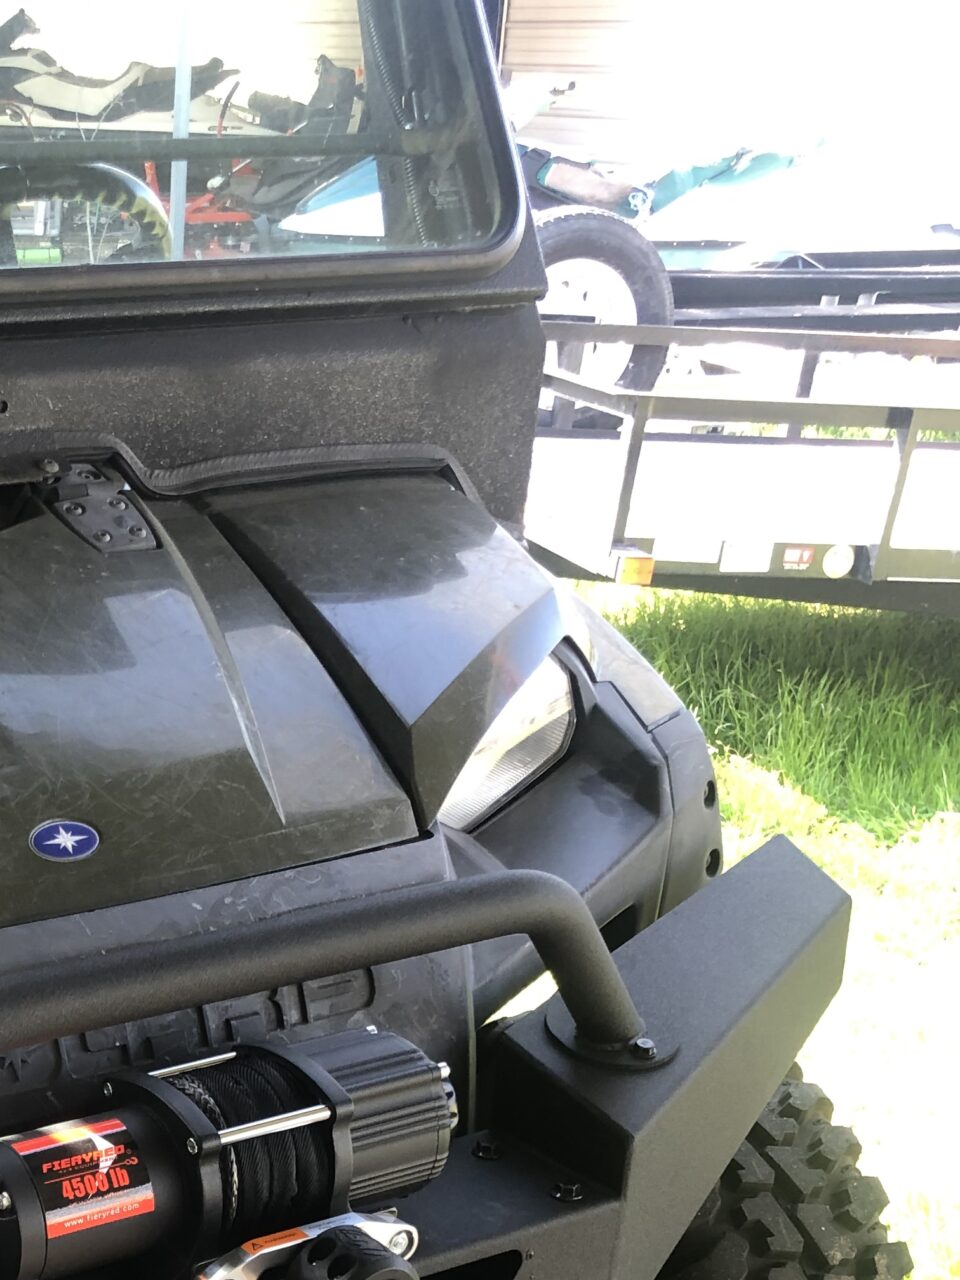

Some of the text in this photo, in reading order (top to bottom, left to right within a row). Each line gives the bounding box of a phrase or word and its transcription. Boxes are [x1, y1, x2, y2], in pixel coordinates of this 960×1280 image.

[42, 1145, 125, 1173] FIERYRED
[62, 1167, 130, 1200] 4500 lb
[64, 1203, 140, 1228] wwwfieryredcom
